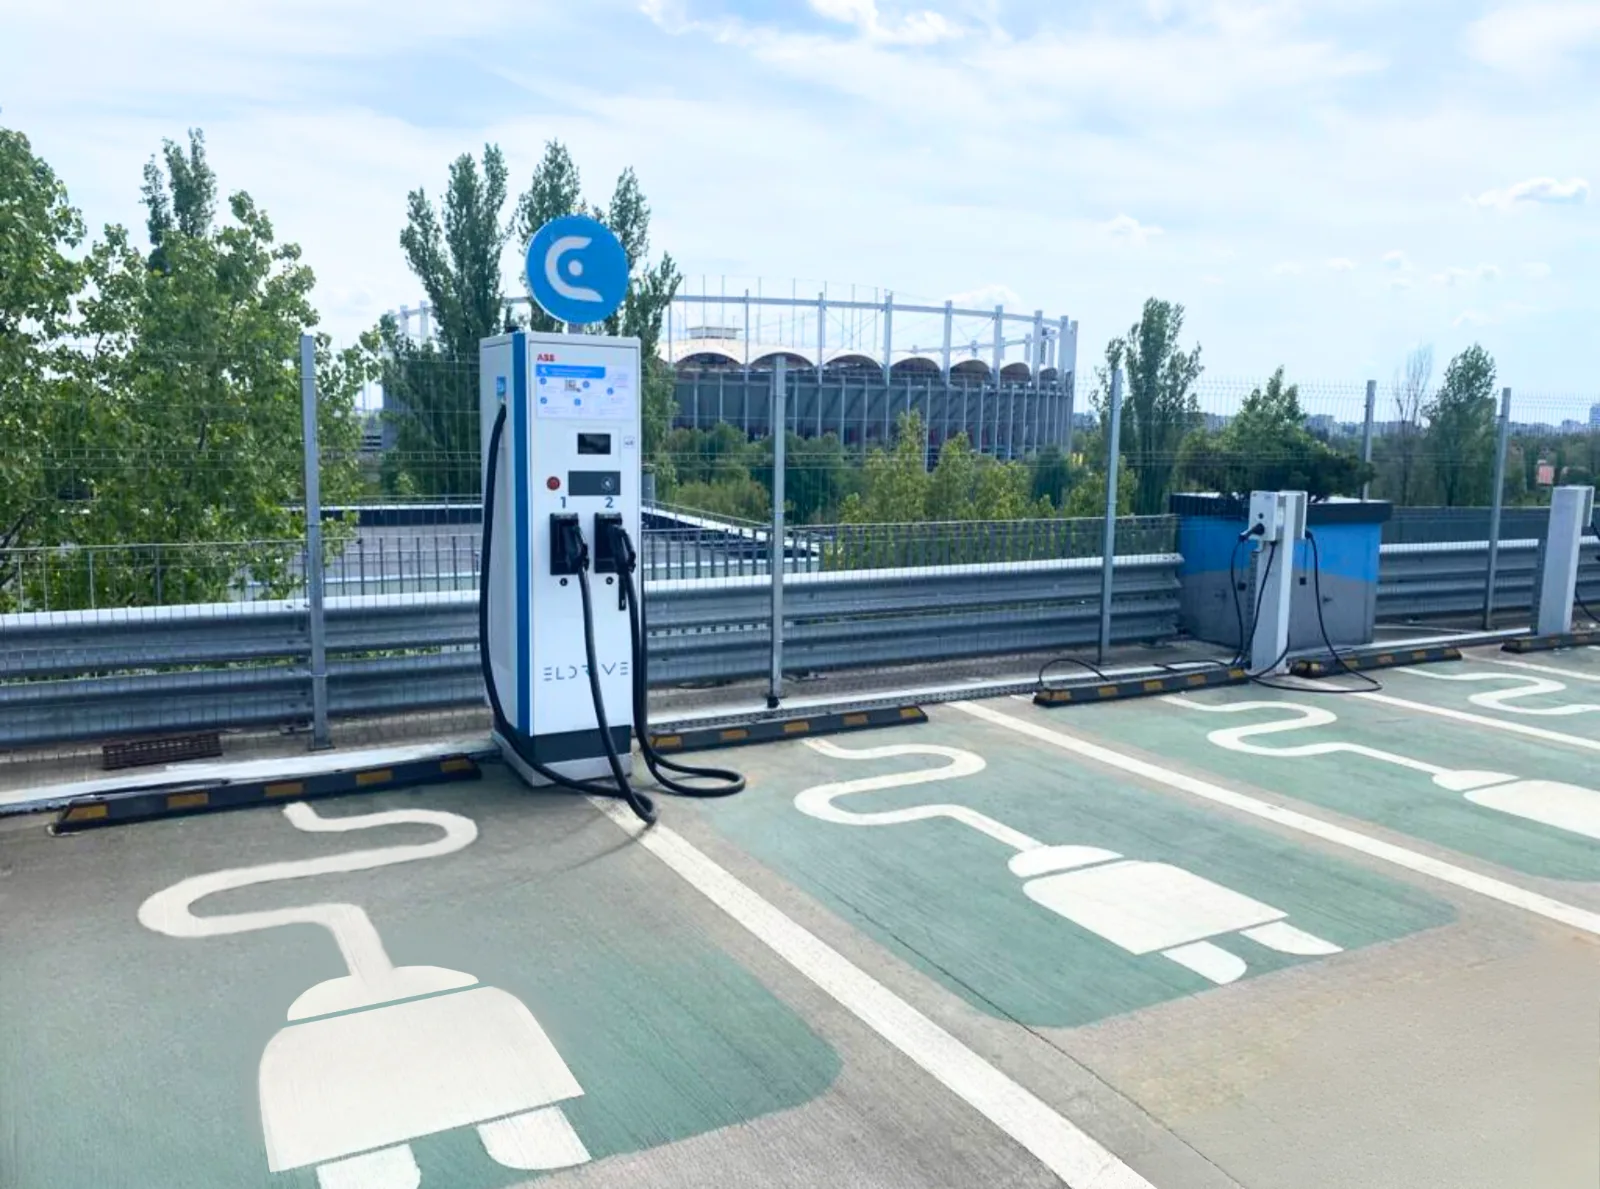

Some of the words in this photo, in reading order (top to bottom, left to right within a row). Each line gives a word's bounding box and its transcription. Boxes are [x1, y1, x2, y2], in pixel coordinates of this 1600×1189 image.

[537, 353, 555, 362] ABB
[560, 496, 566, 508] 1
[605, 496, 614, 508] 2
[543, 661, 629, 682] ELDVE
